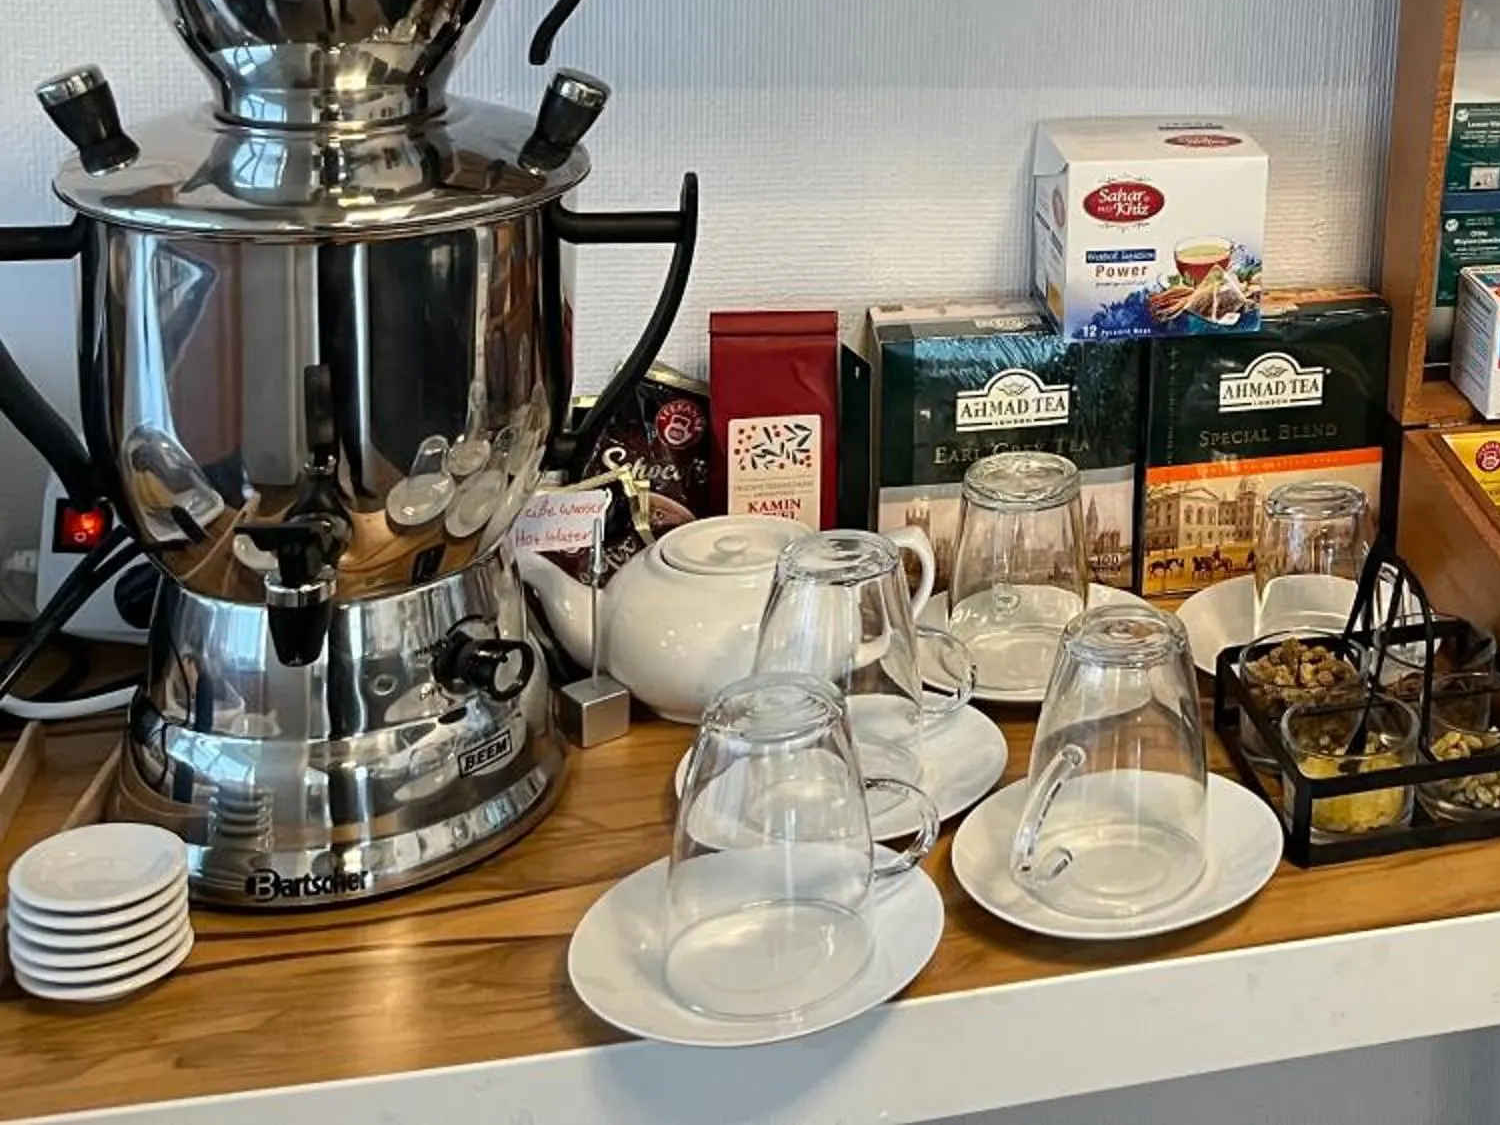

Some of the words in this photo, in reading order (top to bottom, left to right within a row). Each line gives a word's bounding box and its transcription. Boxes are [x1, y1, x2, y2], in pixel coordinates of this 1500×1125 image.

[1098, 187, 1147, 204] Sahar
[1095, 264, 1148, 278] Power
[1082, 324, 1097, 338] 12
[1222, 380, 1288, 400] AHMAD
[1290, 378, 1321, 394] TEA
[960, 397, 1030, 419] AHMAD
[1031, 395, 1067, 414] TEA
[1199, 428, 1271, 448] SPECIAL
[1277, 423, 1339, 441] BLEND
[747, 498, 802, 514] KAMIN
[245, 868, 369, 903] Bartscher
